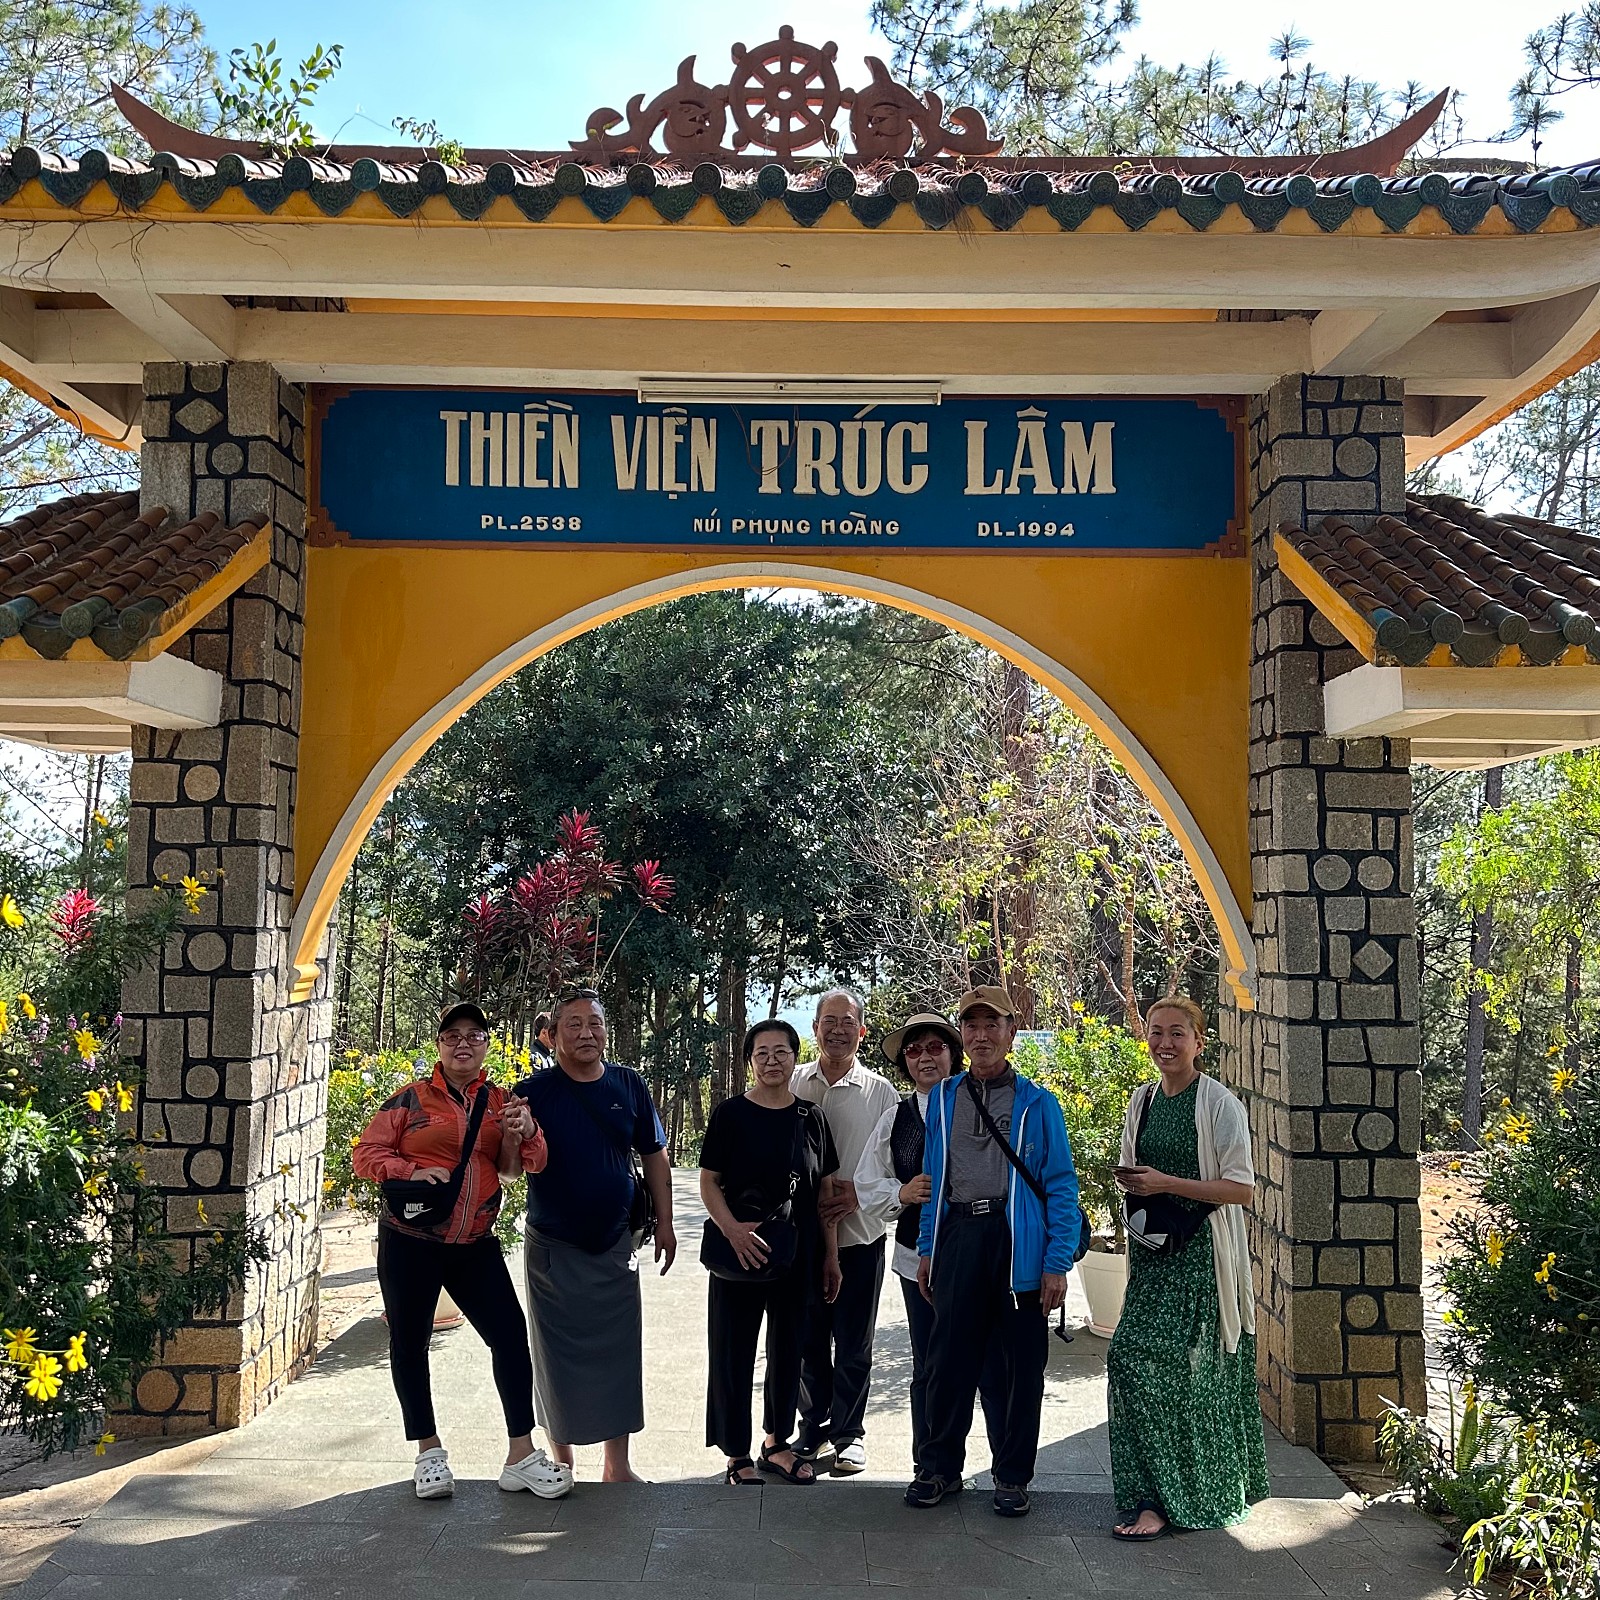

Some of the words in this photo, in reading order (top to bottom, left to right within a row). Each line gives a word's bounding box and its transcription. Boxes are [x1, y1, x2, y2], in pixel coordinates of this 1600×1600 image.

[439, 400, 579, 489] THIỀN
[610, 406, 717, 500] VIỆN
[750, 404, 929, 497] TRÚC
[963, 405, 1117, 495] LÂM
[693, 507, 722, 533] NÚI
[731, 518, 811, 543] PHỤNG
[820, 511, 901, 535] HOÀNG
[405, 1202, 424, 1212] NIKE
